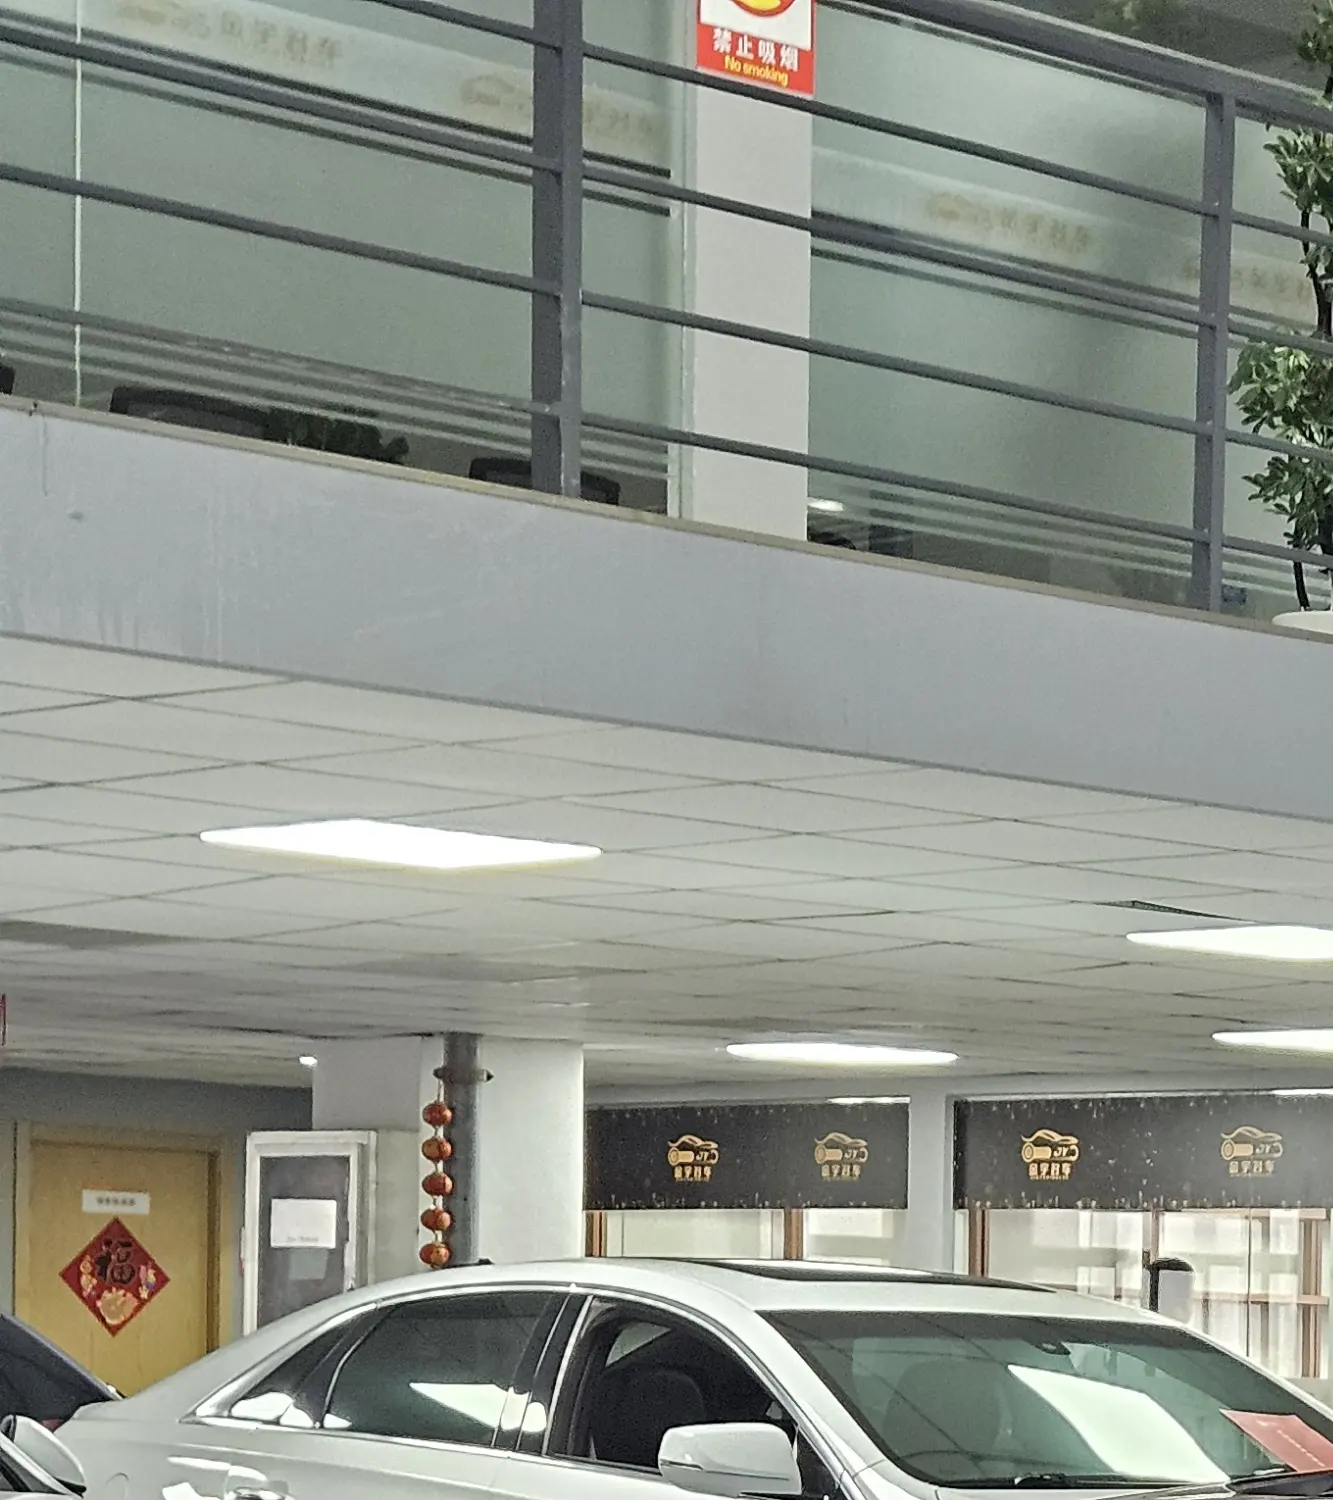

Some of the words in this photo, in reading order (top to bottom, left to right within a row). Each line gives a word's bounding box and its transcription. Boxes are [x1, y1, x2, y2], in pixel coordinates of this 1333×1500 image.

[712, 27, 799, 72] 禁止吸烟
[724, 55, 742, 73] No
[743, 60, 788, 89] smoking
[93, 1237, 137, 1285] 福
